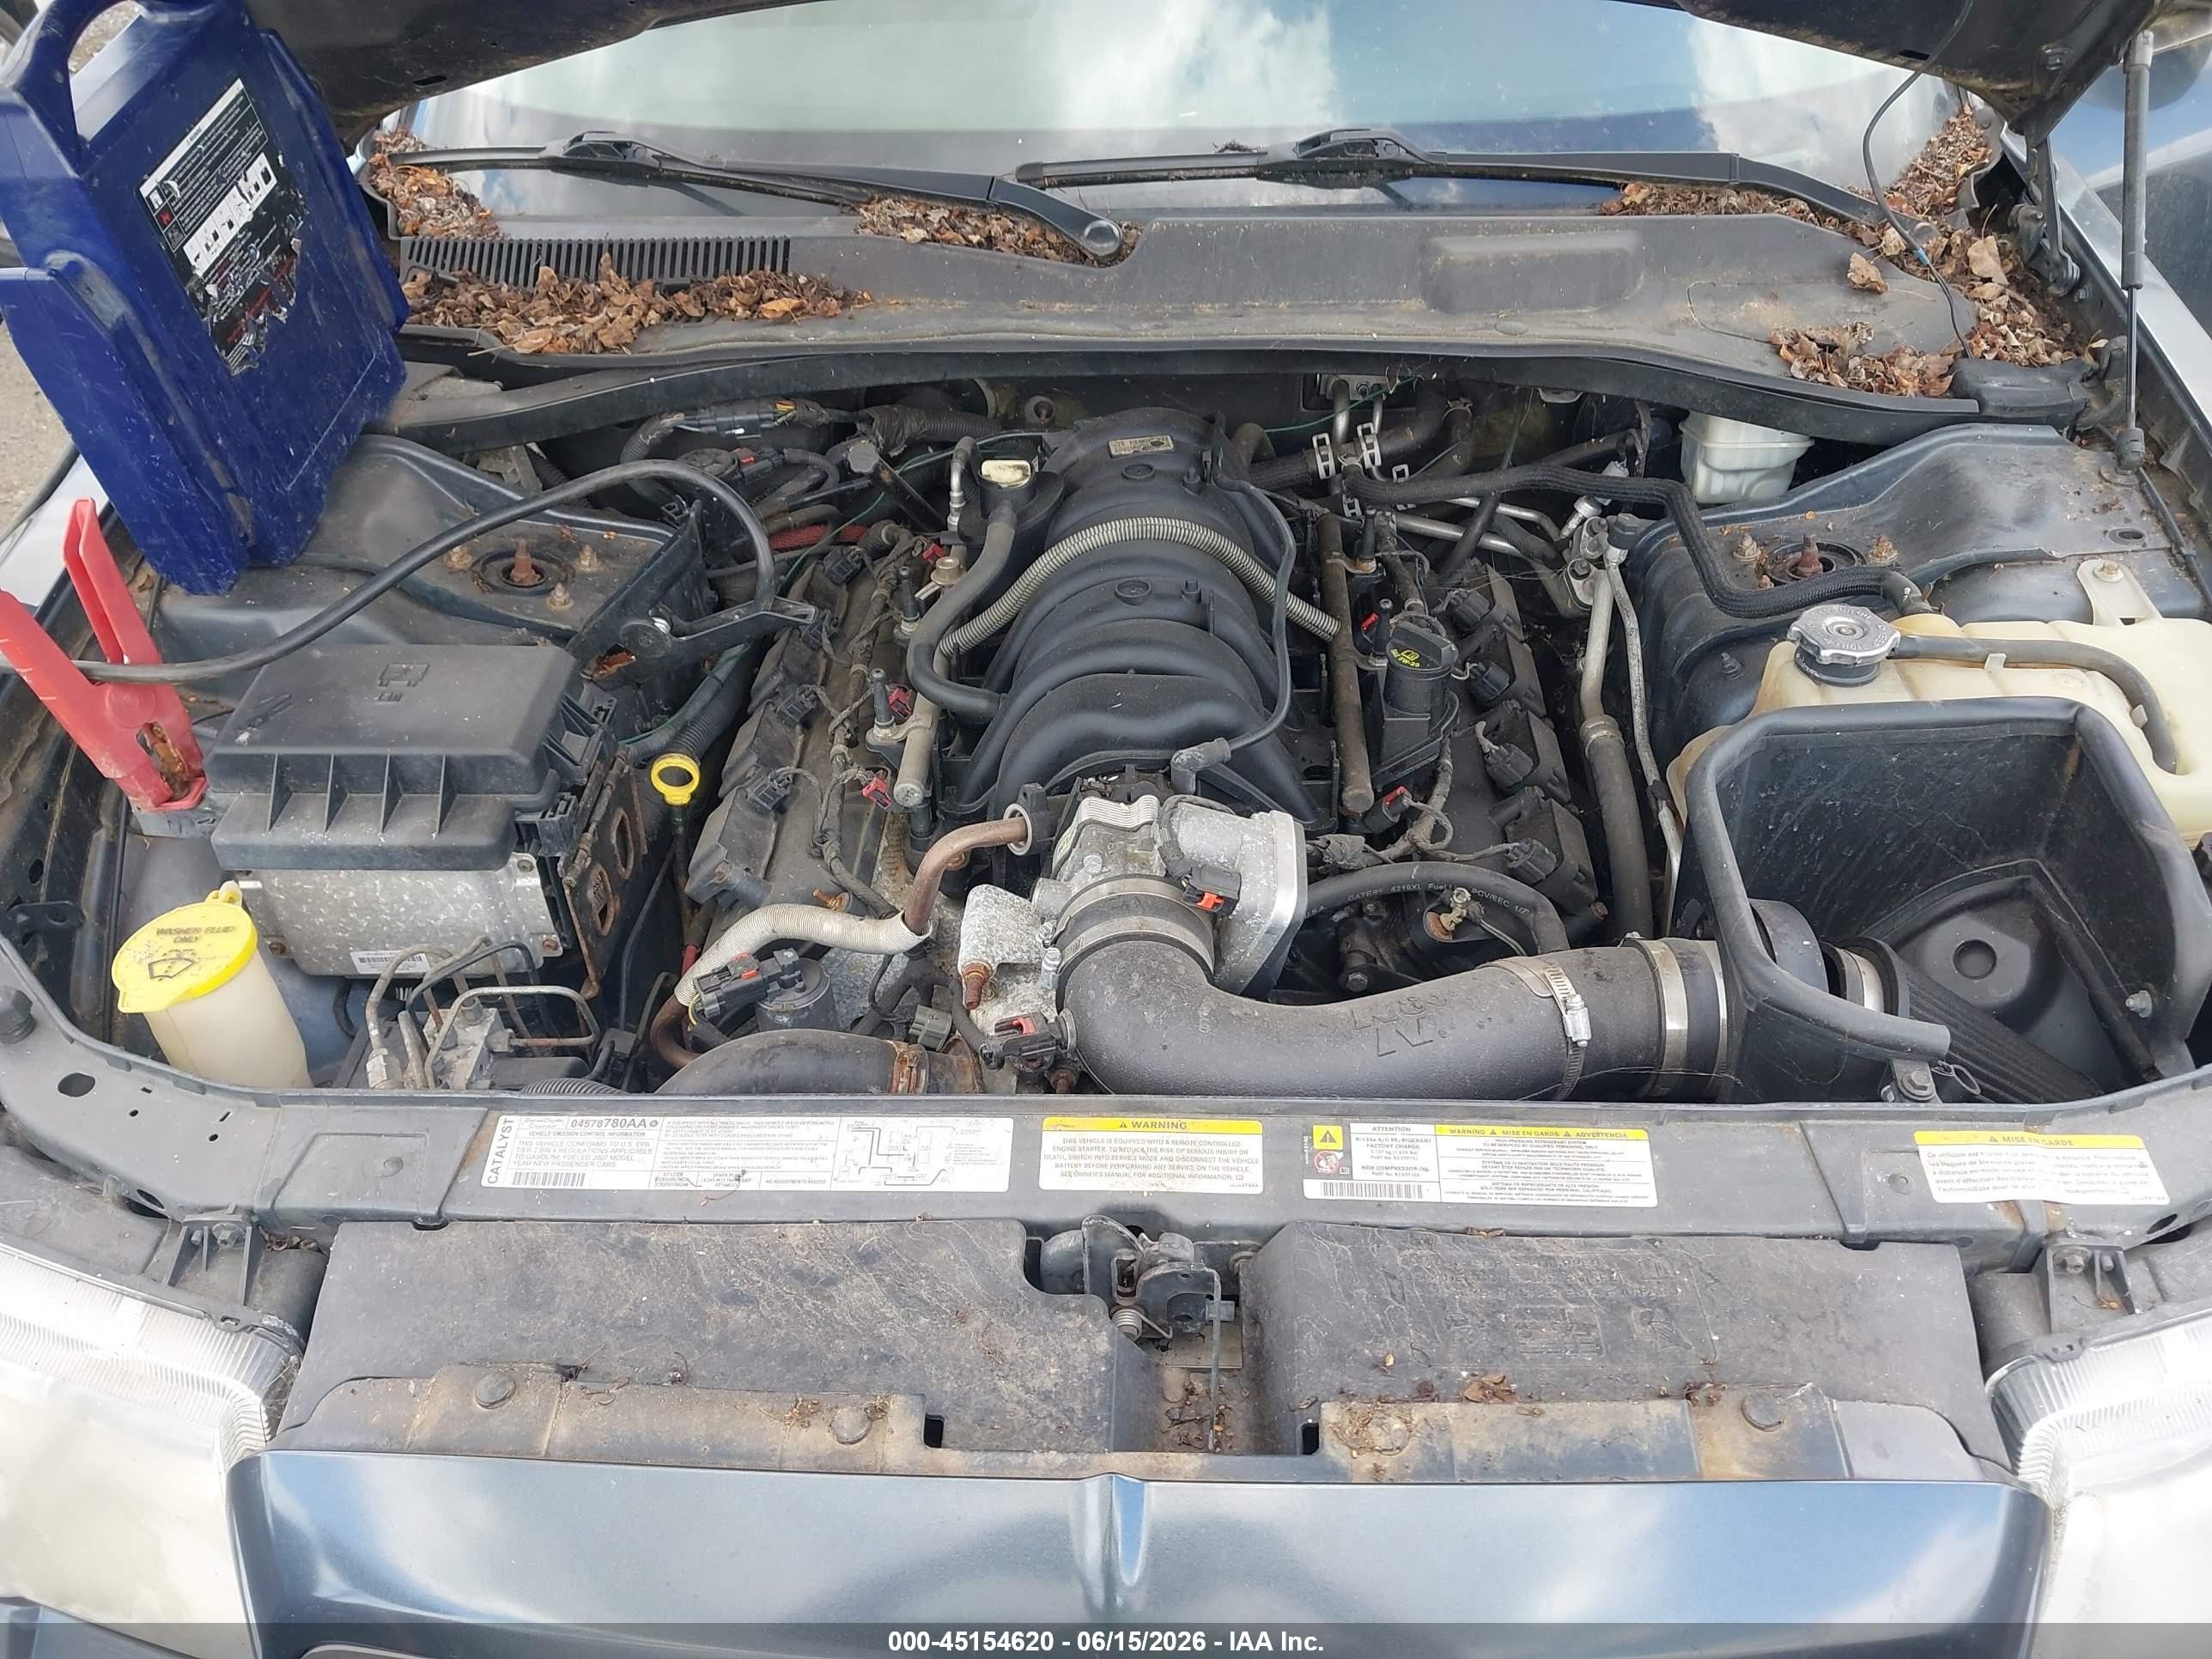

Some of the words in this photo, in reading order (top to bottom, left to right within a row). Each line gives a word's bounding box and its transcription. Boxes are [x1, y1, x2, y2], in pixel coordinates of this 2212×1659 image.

[1398, 657, 1420, 667] 5W-20
[571, 1117, 647, 1128] 04578780AA
[1132, 1121, 1188, 1130] WARNING
[487, 1117, 514, 1184] CATALYST
